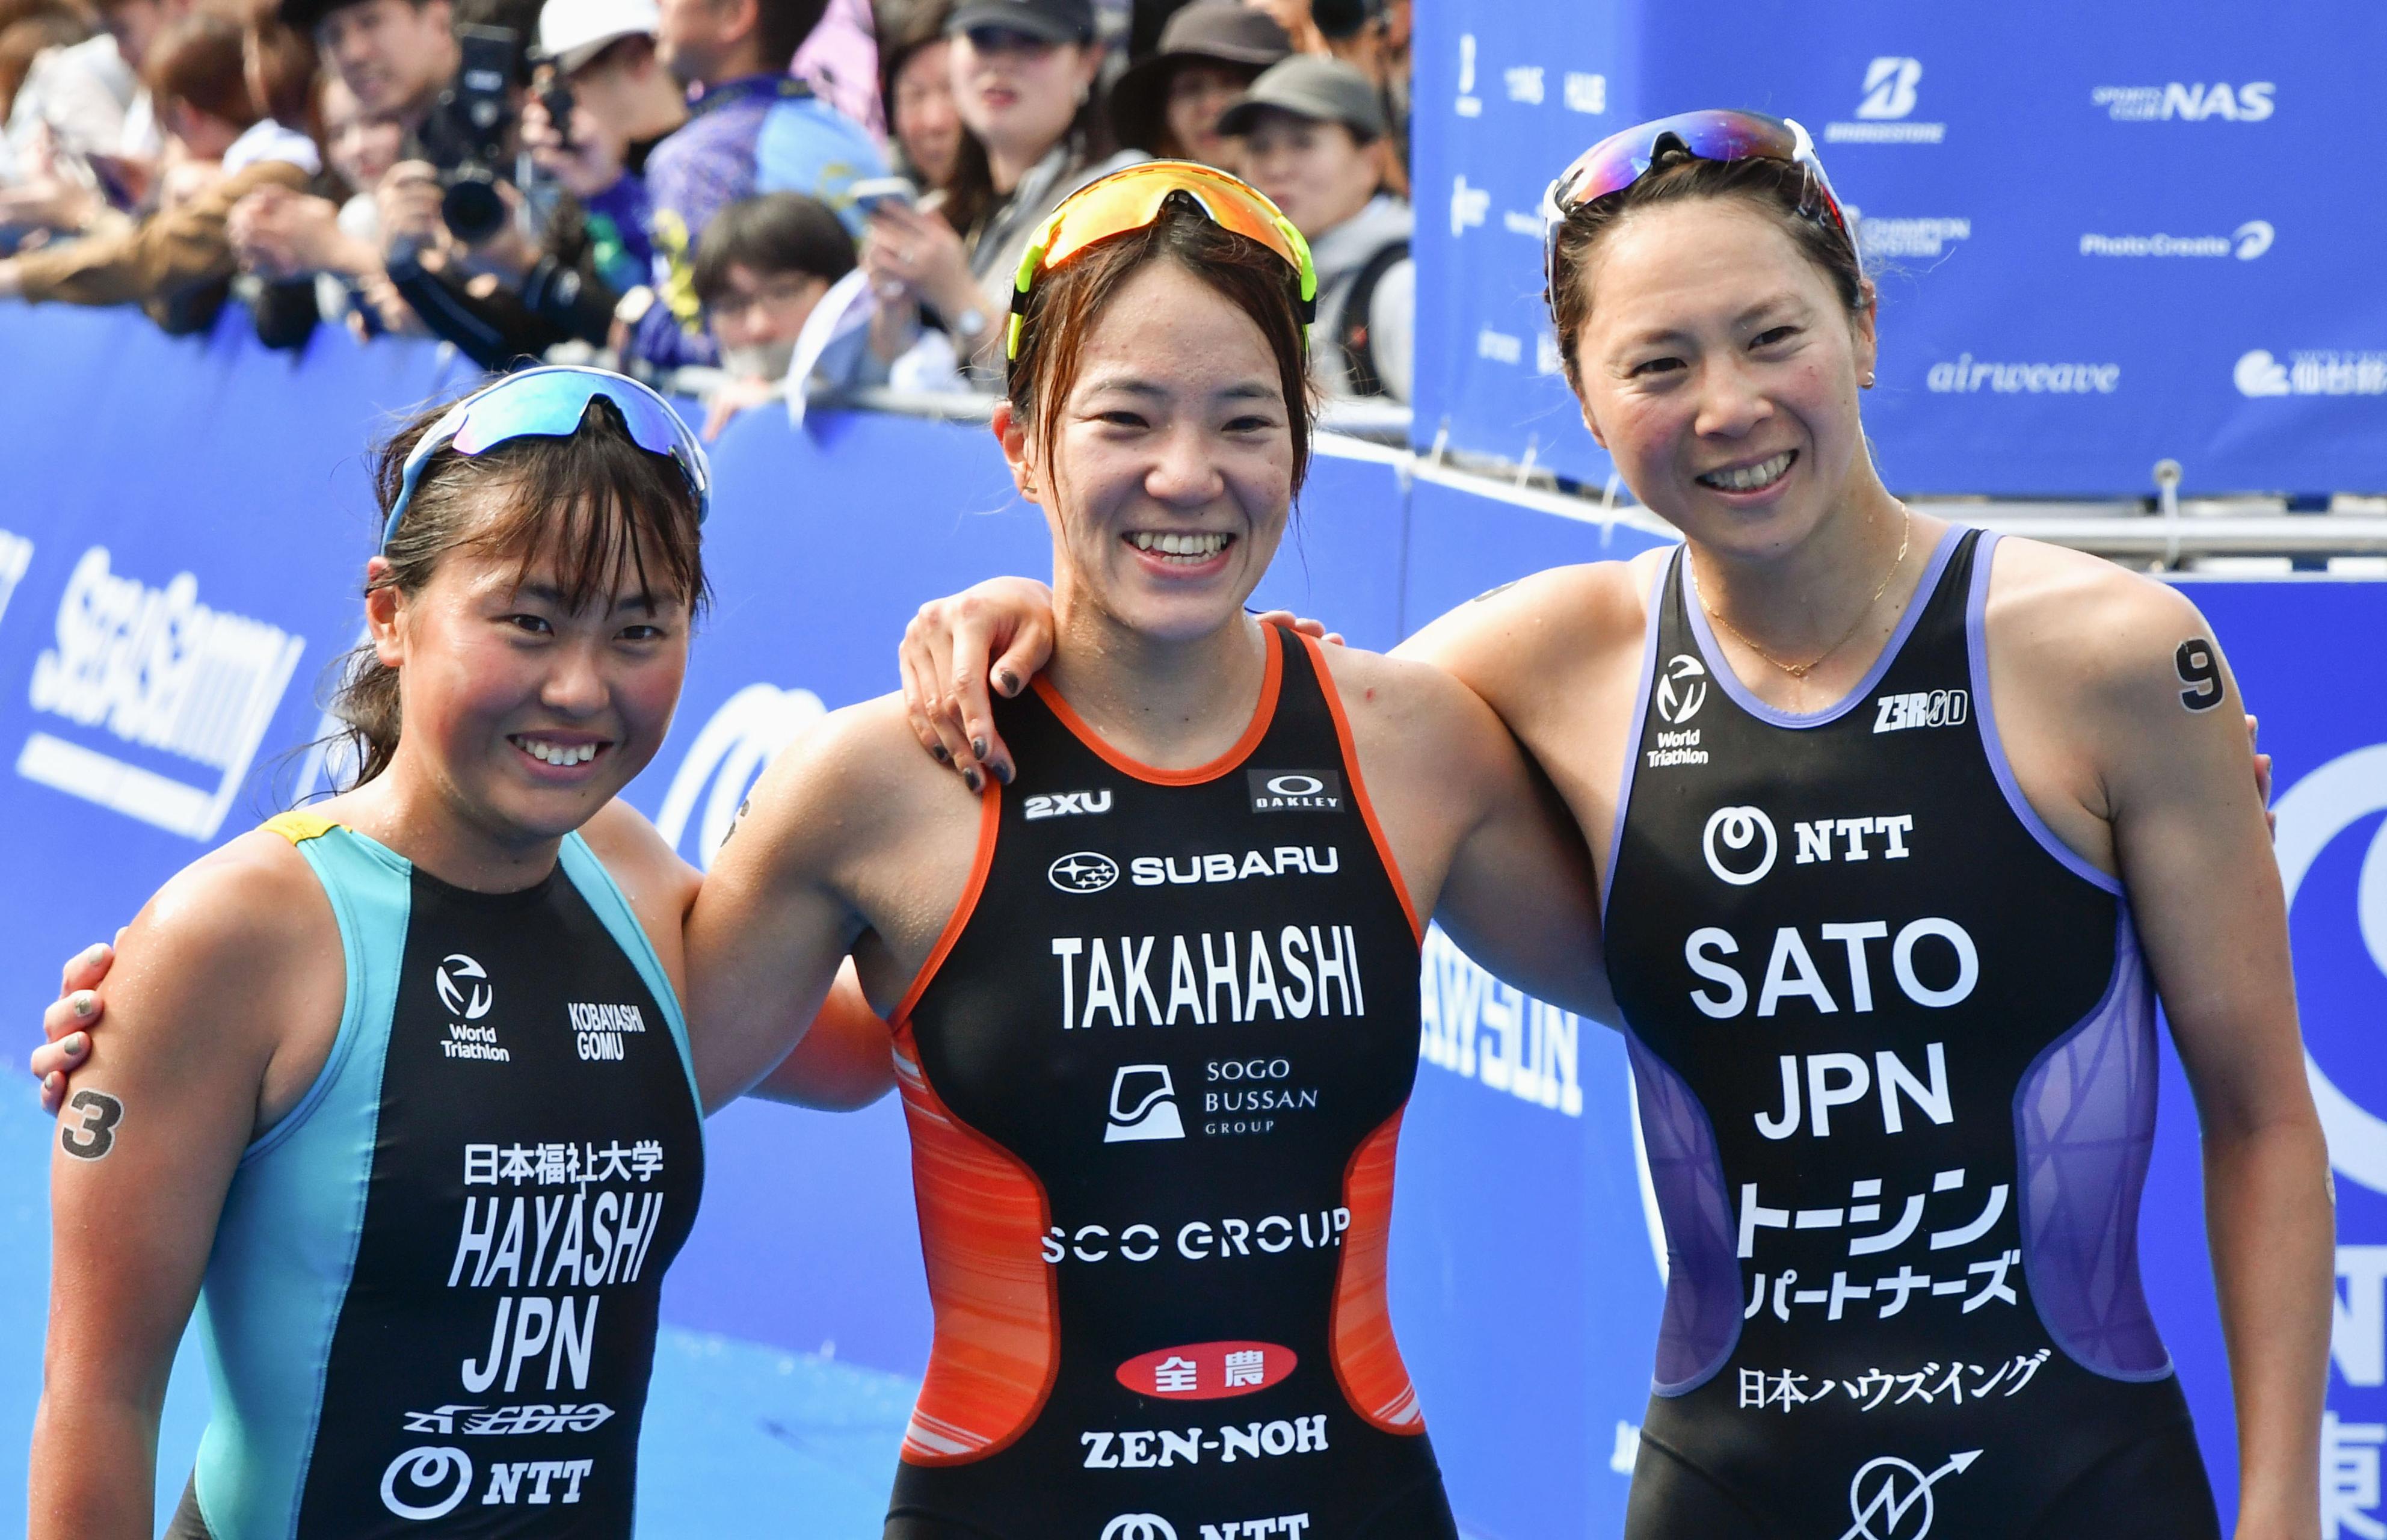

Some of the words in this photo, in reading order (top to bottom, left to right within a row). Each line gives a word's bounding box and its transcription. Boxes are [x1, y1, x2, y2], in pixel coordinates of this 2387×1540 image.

[2161, 81, 2276, 121] NAS
[1927, 353, 2120, 394] airweave
[2173, 636, 2225, 713] 9
[1646, 747, 1708, 768] Triathlon
[1657, 728, 1700, 748] World
[1024, 790, 1111, 819] 2XU
[1255, 796, 1339, 808] OAKLEY
[1794, 815, 1913, 864] NTT
[1131, 846, 1338, 885] SUBARU
[1052, 926, 1364, 1029] TAKAHASHI
[1686, 917, 1979, 1018] SATO
[448, 1024, 497, 1044] World
[568, 1003, 645, 1033] KOBAYASHI
[1421, 920, 1583, 1119] AWSON
[440, 1038, 510, 1062] Triathlon
[578, 1030, 626, 1060] GOMU
[1207, 1059, 1290, 1082] SOGO
[1755, 1043, 1953, 1139] JPN
[1206, 1090, 1317, 1112] BUSSAN
[61, 1088, 125, 1162] 3
[1206, 1120, 1274, 1135] GROUP
[464, 1139, 664, 1186] 日本福祉大学
[1041, 1224, 1160, 1263] SCO
[1177, 1207, 1351, 1260] GROUP
[1737, 1169, 2011, 1260] トーシン
[446, 1190, 664, 1287] HAYASHI
[1743, 1248, 2022, 1323] パートナーズ
[462, 1295, 599, 1393] JPN
[1156, 1350, 1264, 1392] 全農
[1740, 1349, 2051, 1412] 日本ハウズイング
[1081, 1415, 1328, 1468] ZEN-NOH
[482, 1459, 593, 1505] NTT
